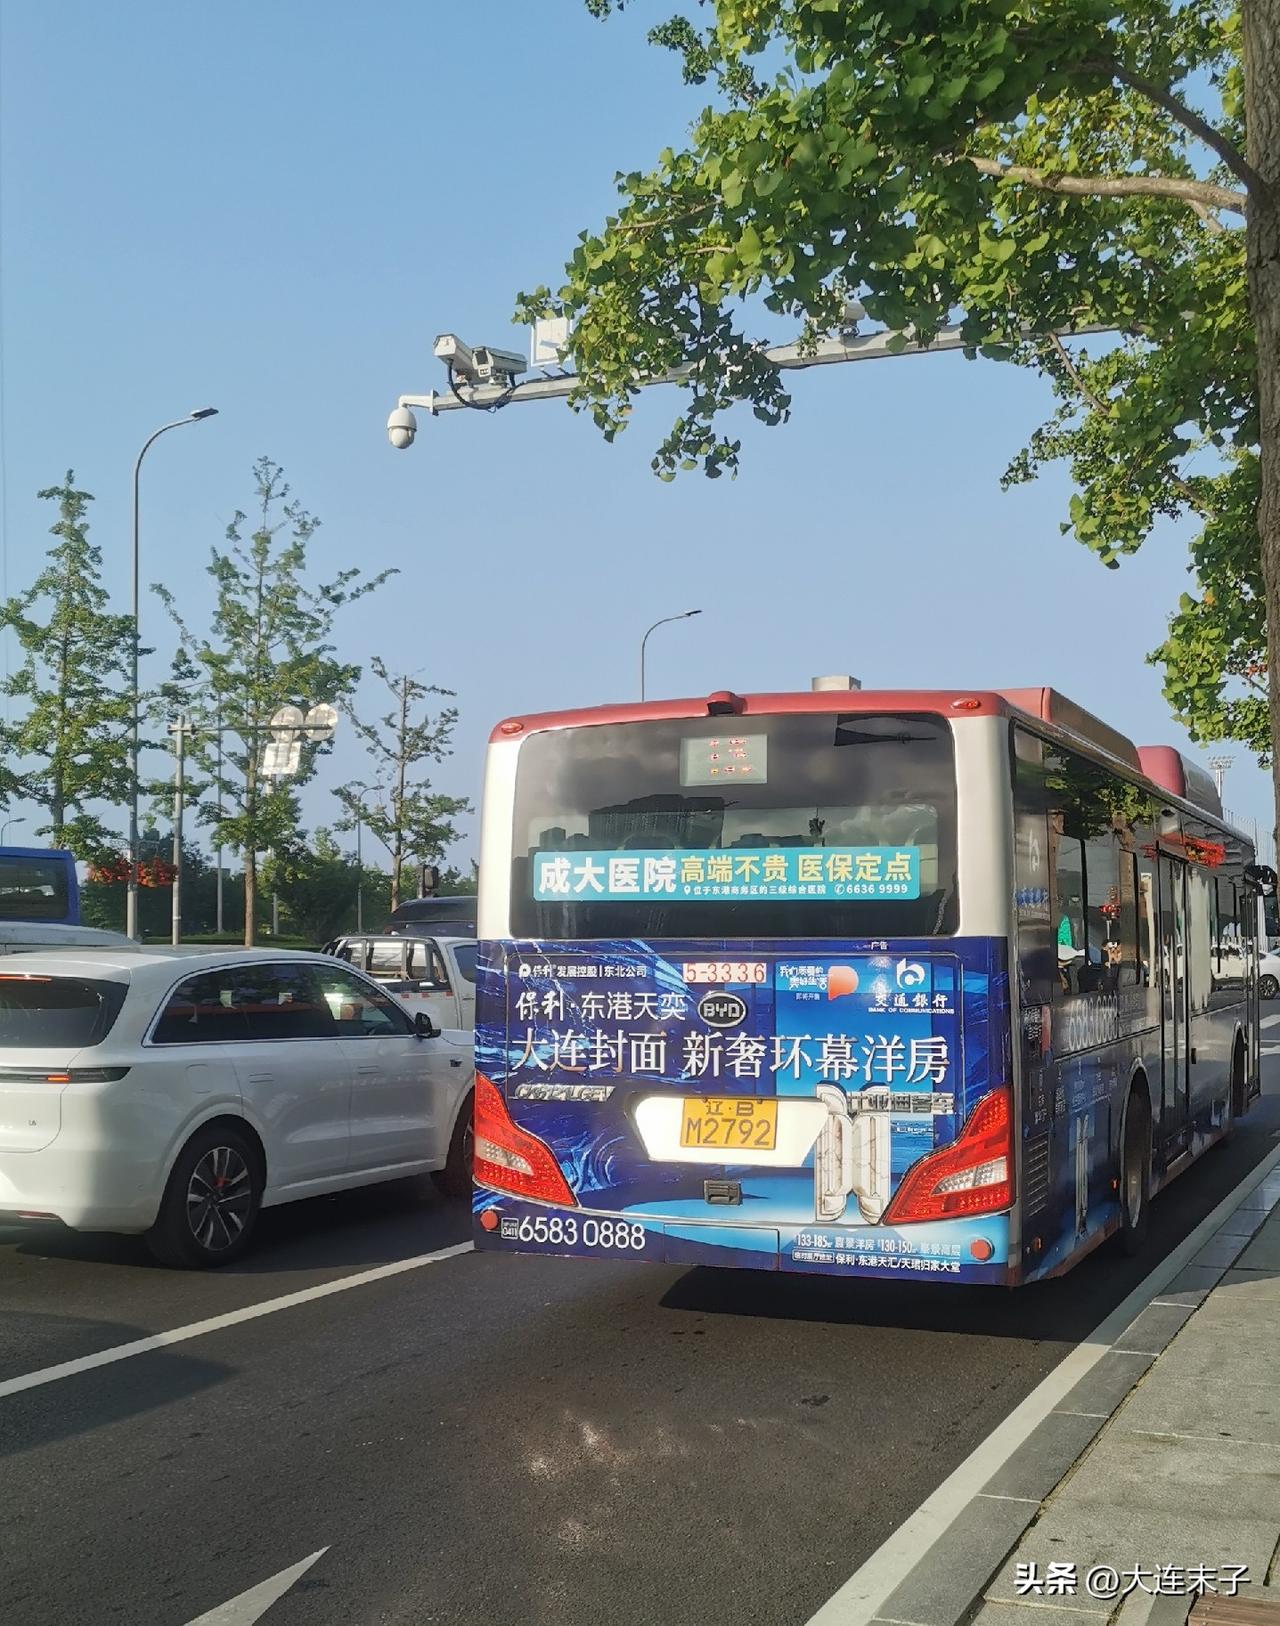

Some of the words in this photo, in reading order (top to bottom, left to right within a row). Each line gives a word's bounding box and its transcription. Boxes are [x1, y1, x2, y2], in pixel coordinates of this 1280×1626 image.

[539, 857, 677, 894] 成大医院
[681, 854, 789, 884] 高端不贵
[798, 852, 913, 883] 医保定点
[846, 884, 875, 894] 6636
[879, 884, 908, 894] 9999
[685, 964, 766, 983] 5-3336
[511, 1028, 667, 1074] 大连封面
[682, 1030, 950, 1084] 新奢环幕洋房
[685, 1117, 771, 1145] M2792
[519, 1216, 578, 1245] 6583
[583, 1220, 646, 1250] 0888
